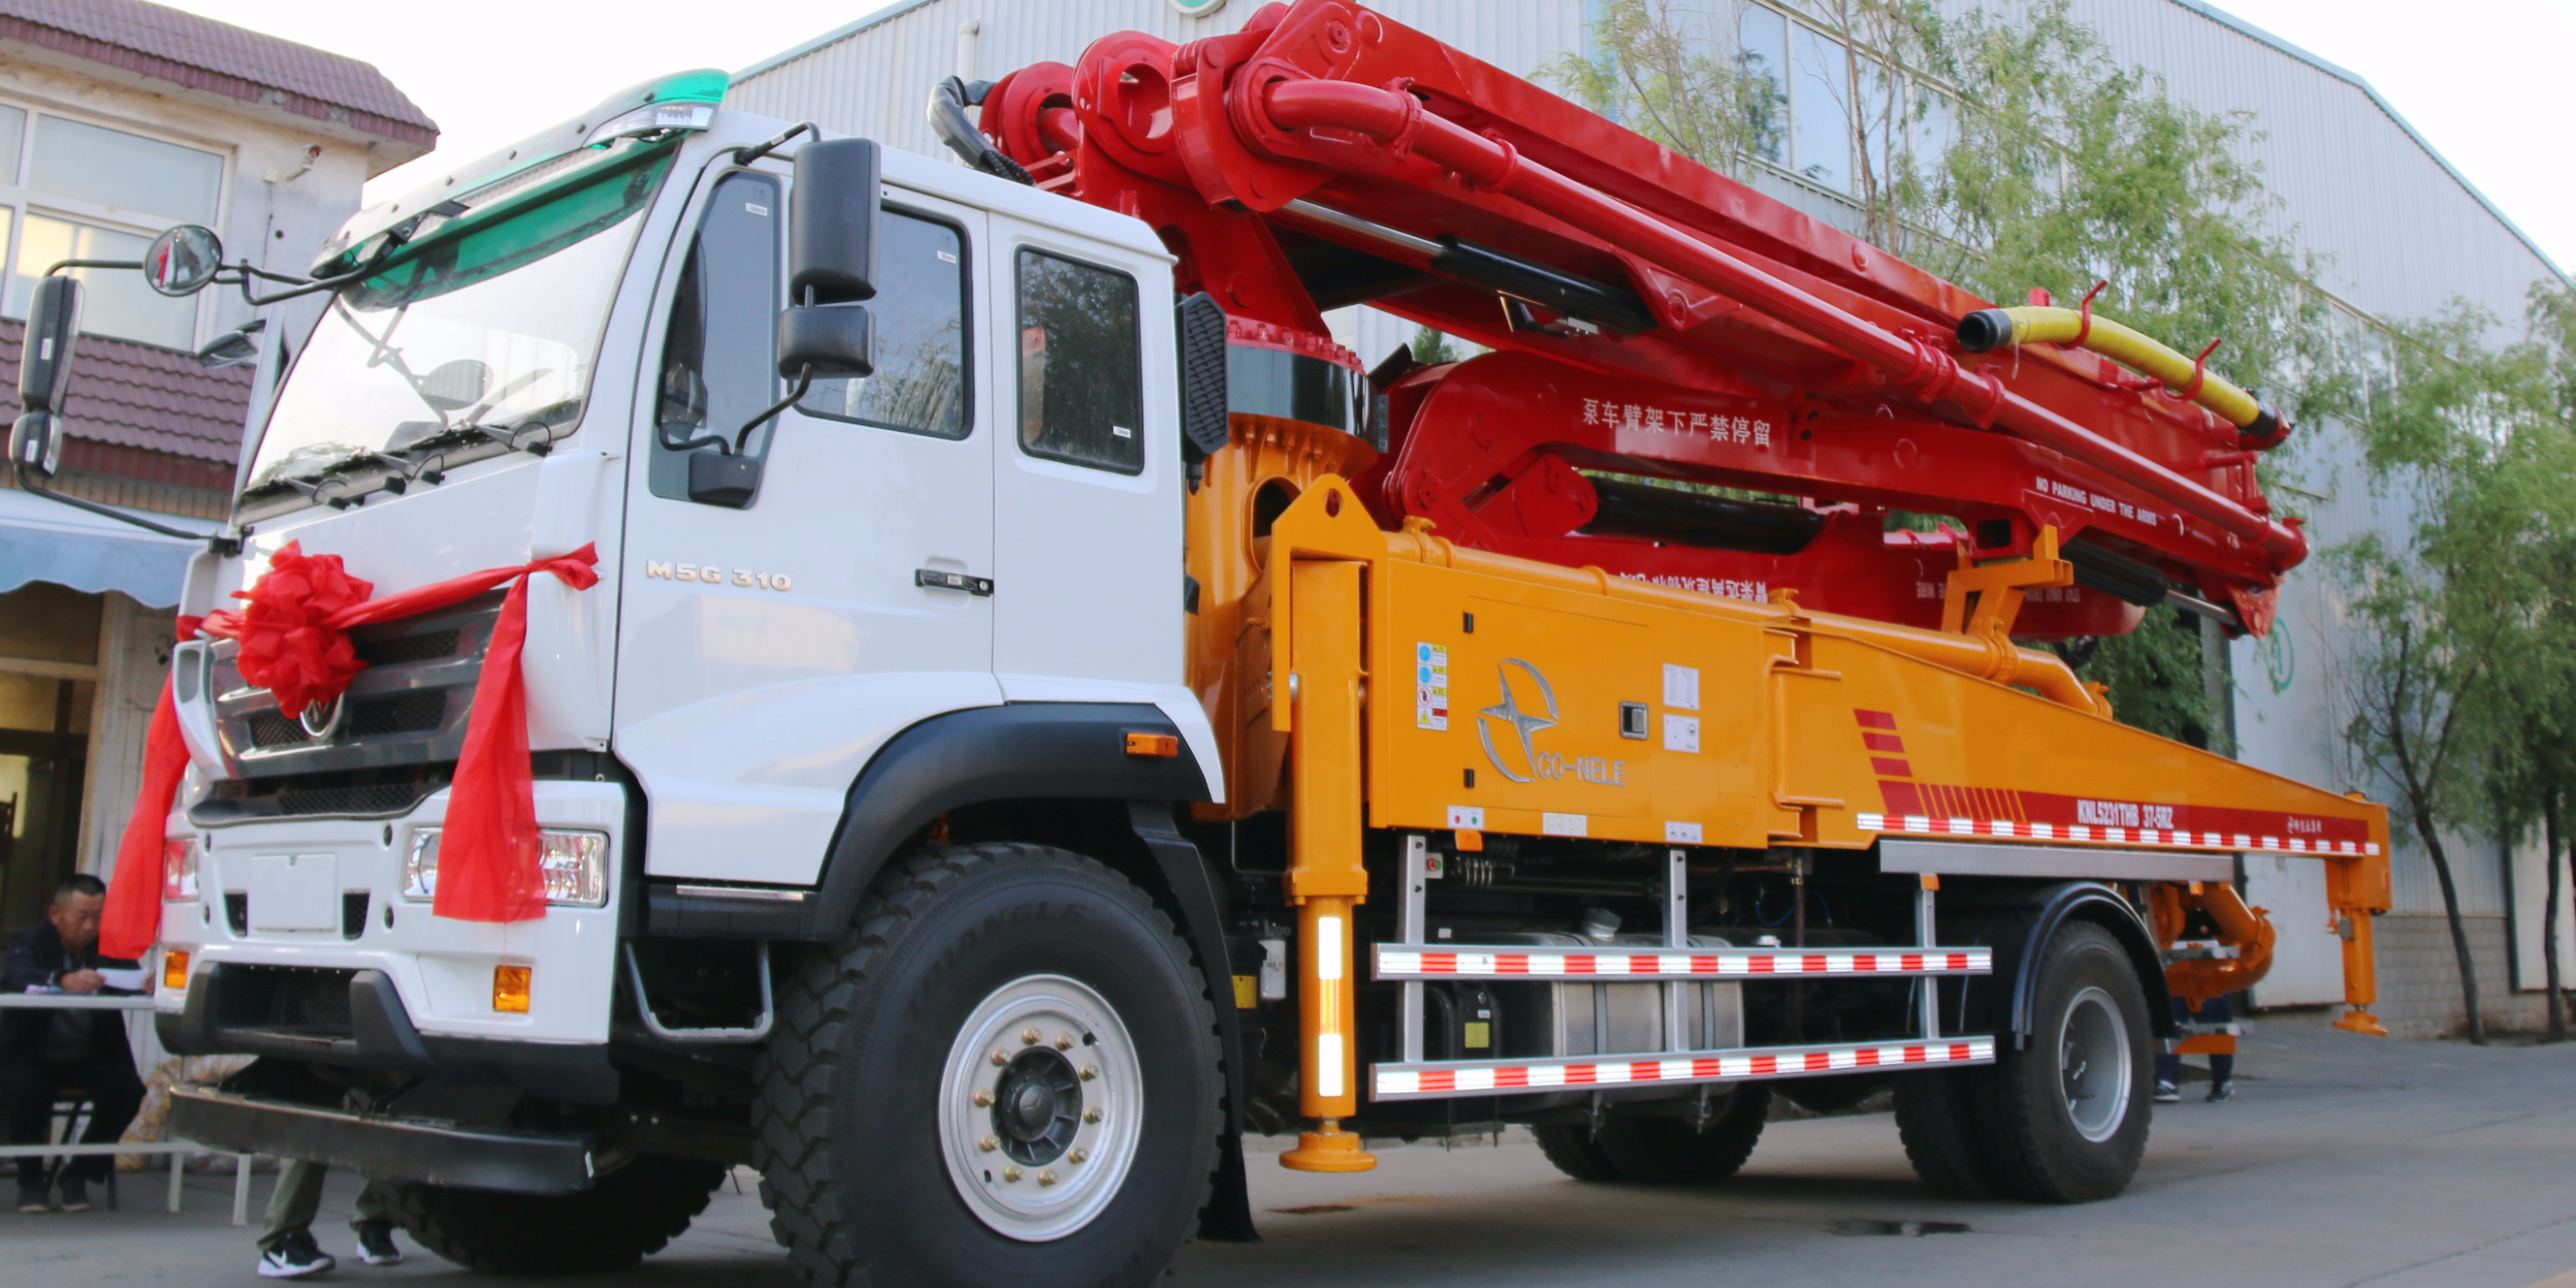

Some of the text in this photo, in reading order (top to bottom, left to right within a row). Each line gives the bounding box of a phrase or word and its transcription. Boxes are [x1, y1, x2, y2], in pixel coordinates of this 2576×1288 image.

[1583, 398, 1771, 447] 泵车臂架下严禁停留
[2036, 476, 2157, 526] NO PARKING UNDER THE ARMS
[647, 560, 792, 592] M5G 310
[1537, 751, 1626, 787] CO-NELE
